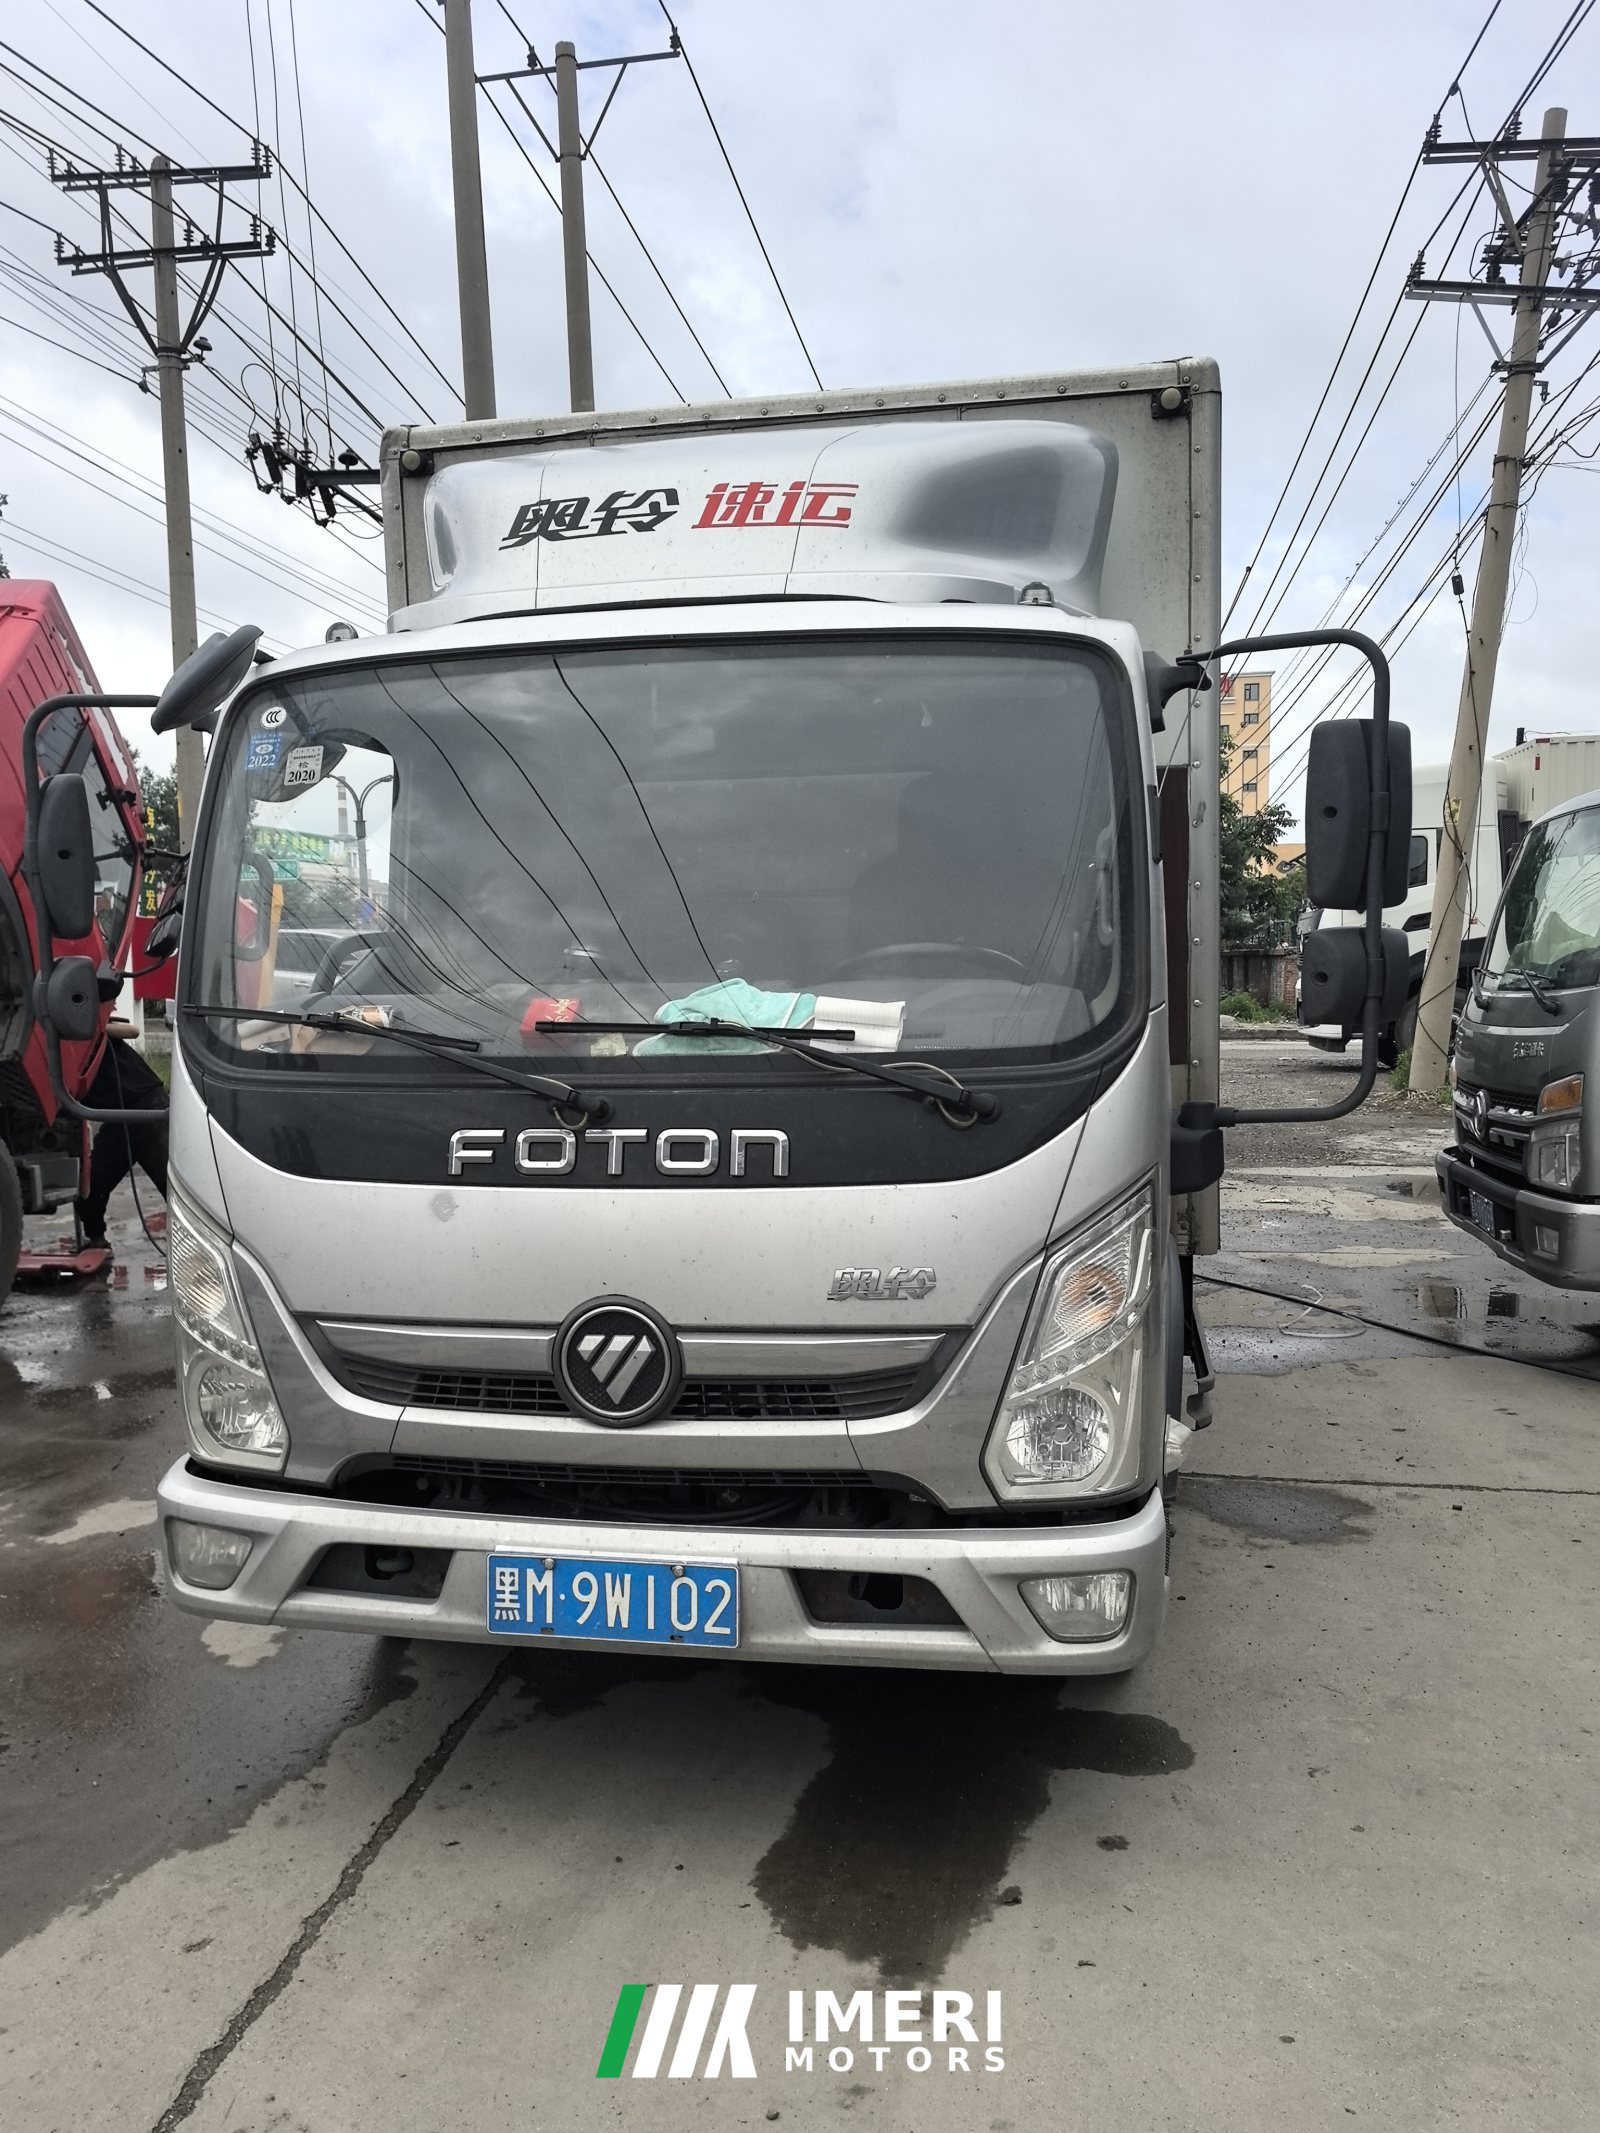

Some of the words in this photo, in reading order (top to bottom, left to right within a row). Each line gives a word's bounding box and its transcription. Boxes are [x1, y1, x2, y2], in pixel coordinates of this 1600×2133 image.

[498, 488, 680, 551] 奥铃
[691, 481, 859, 530] 速运
[247, 754, 276, 768] 2022
[287, 769, 316, 783] 2020
[447, 1128, 791, 1177] FOTON
[827, 1266, 937, 1301] 奥铃
